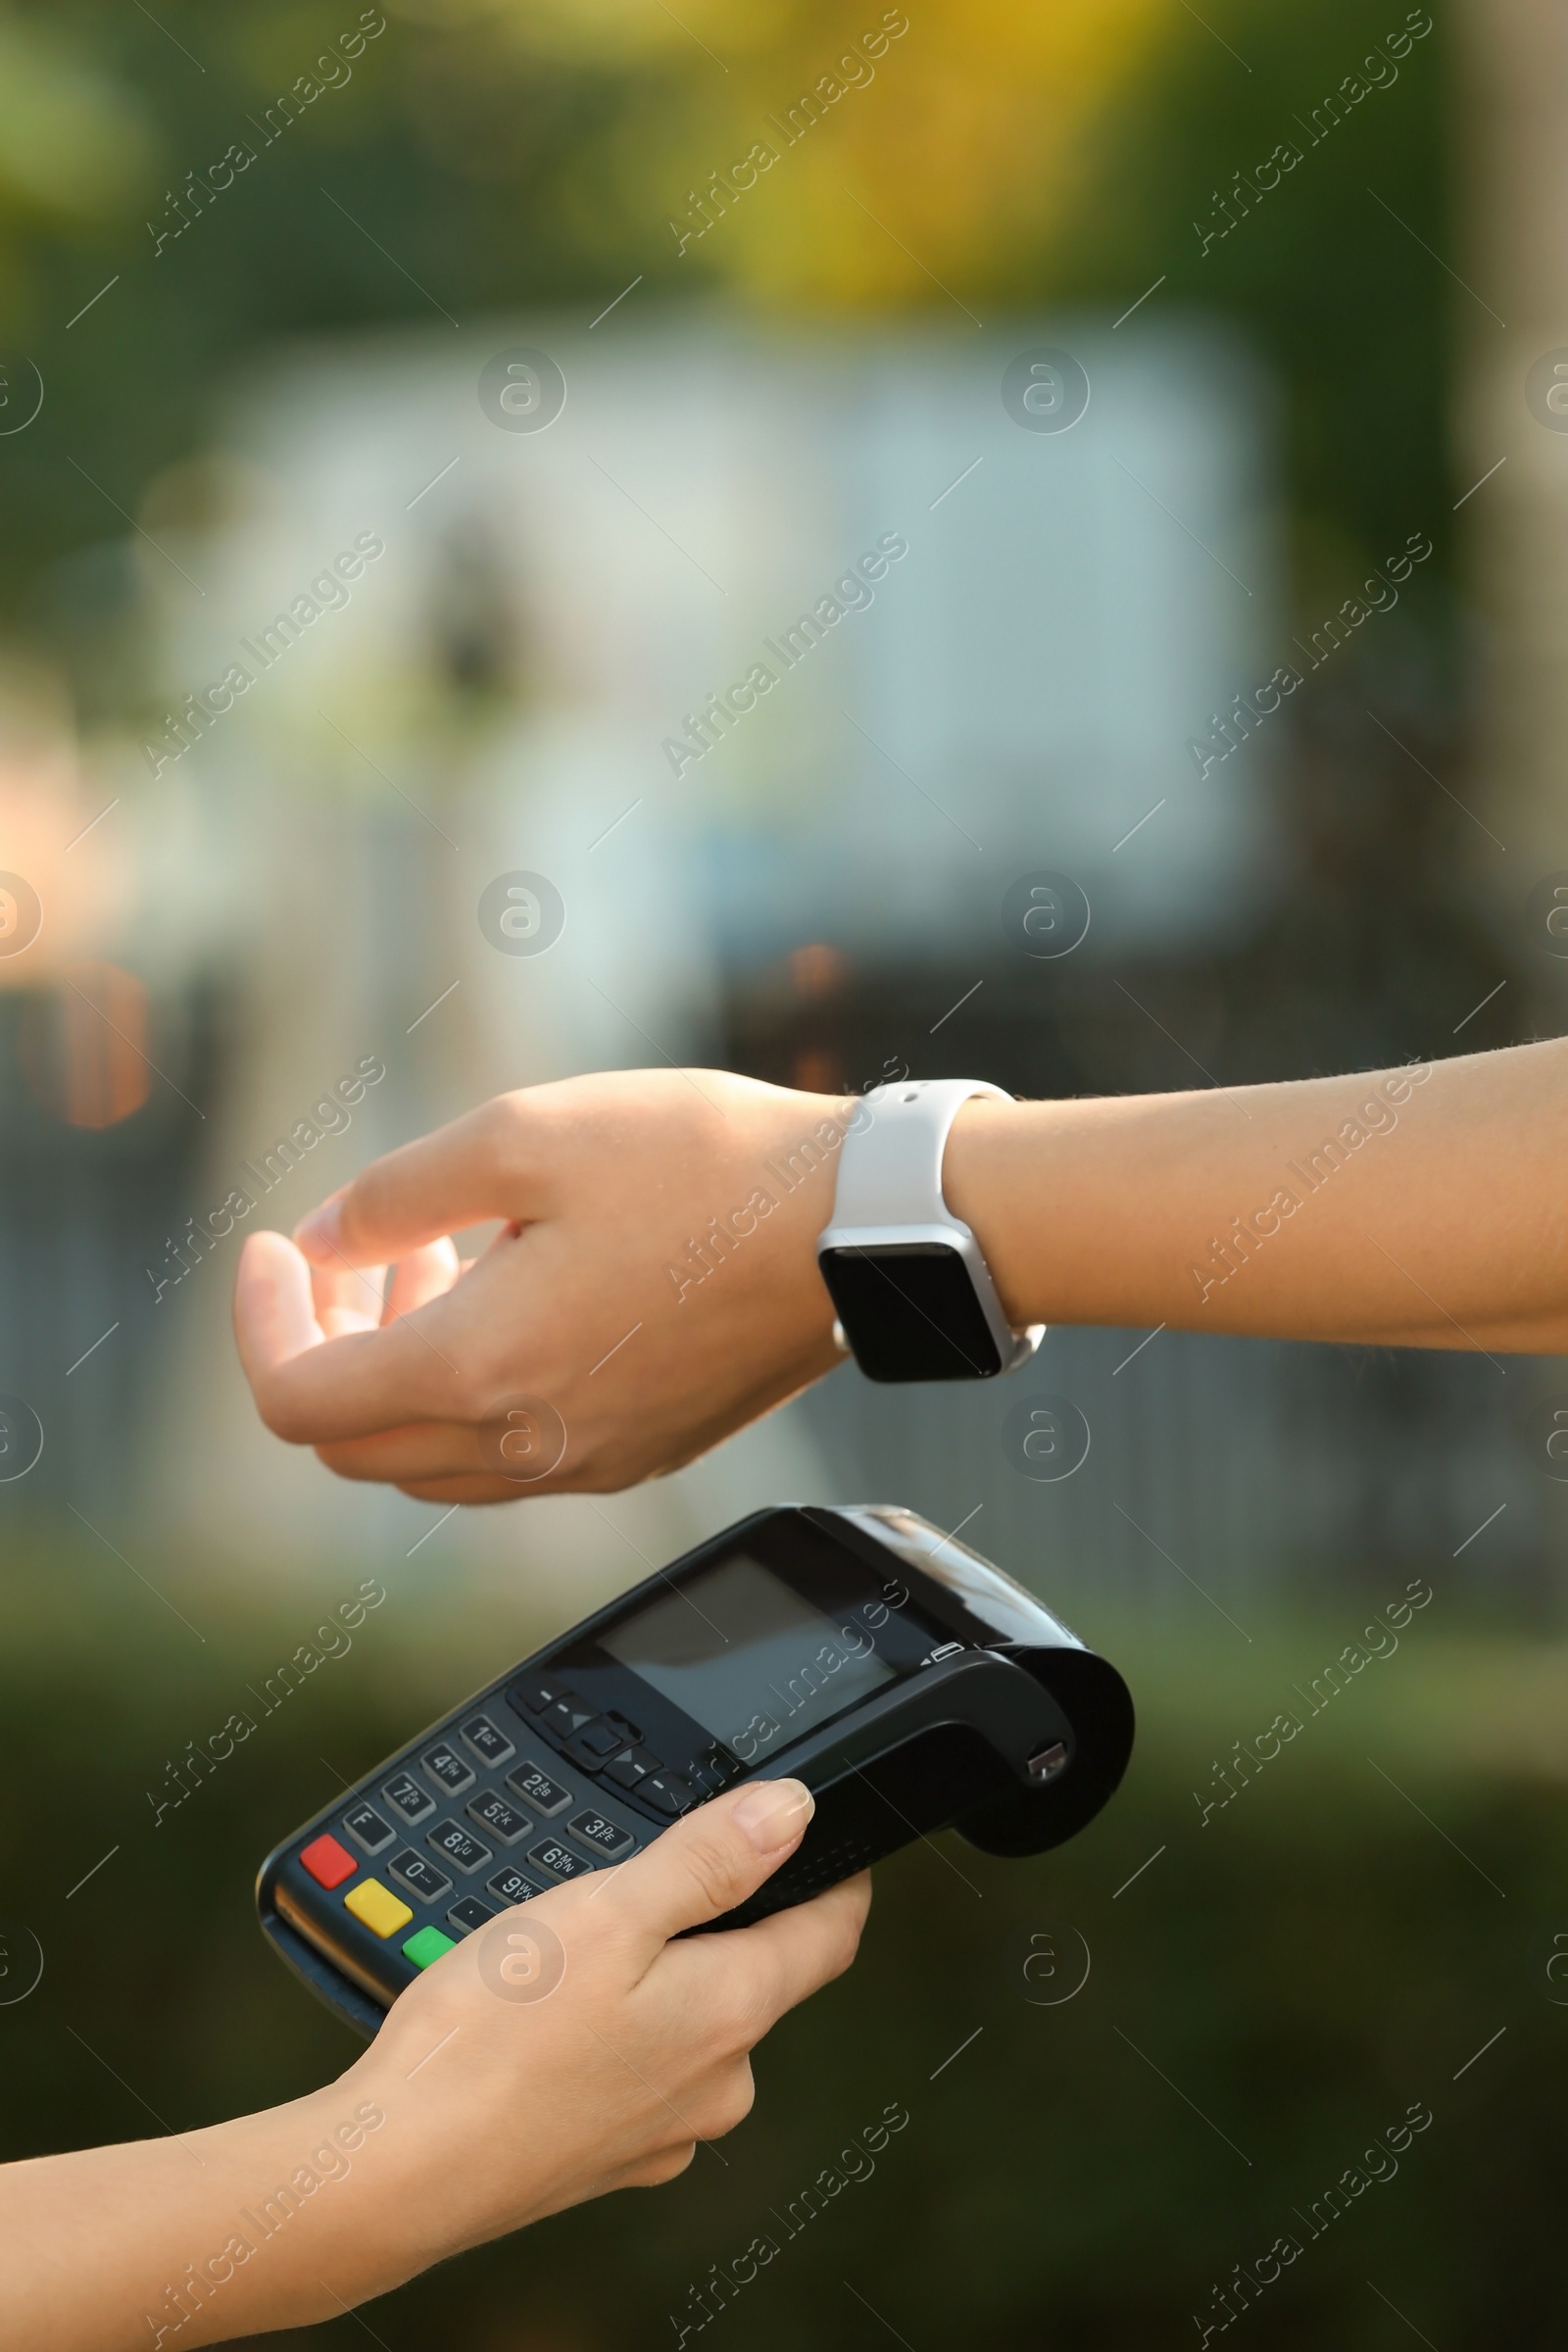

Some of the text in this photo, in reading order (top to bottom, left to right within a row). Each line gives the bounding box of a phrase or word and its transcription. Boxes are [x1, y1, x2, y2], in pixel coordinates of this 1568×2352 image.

[473, 1726, 489, 1740] 1
[433, 1755, 452, 1769] 4
[393, 1782, 413, 1797] 7
[522, 1774, 542, 1790] 2
[353, 1811, 373, 1825] F
[483, 1802, 504, 1818] 5
[585, 1819, 605, 1835] 3
[444, 1832, 464, 1848] 8
[543, 1847, 562, 1863] 6
[405, 1862, 425, 1878] 0
[502, 1877, 521, 1893] 9
